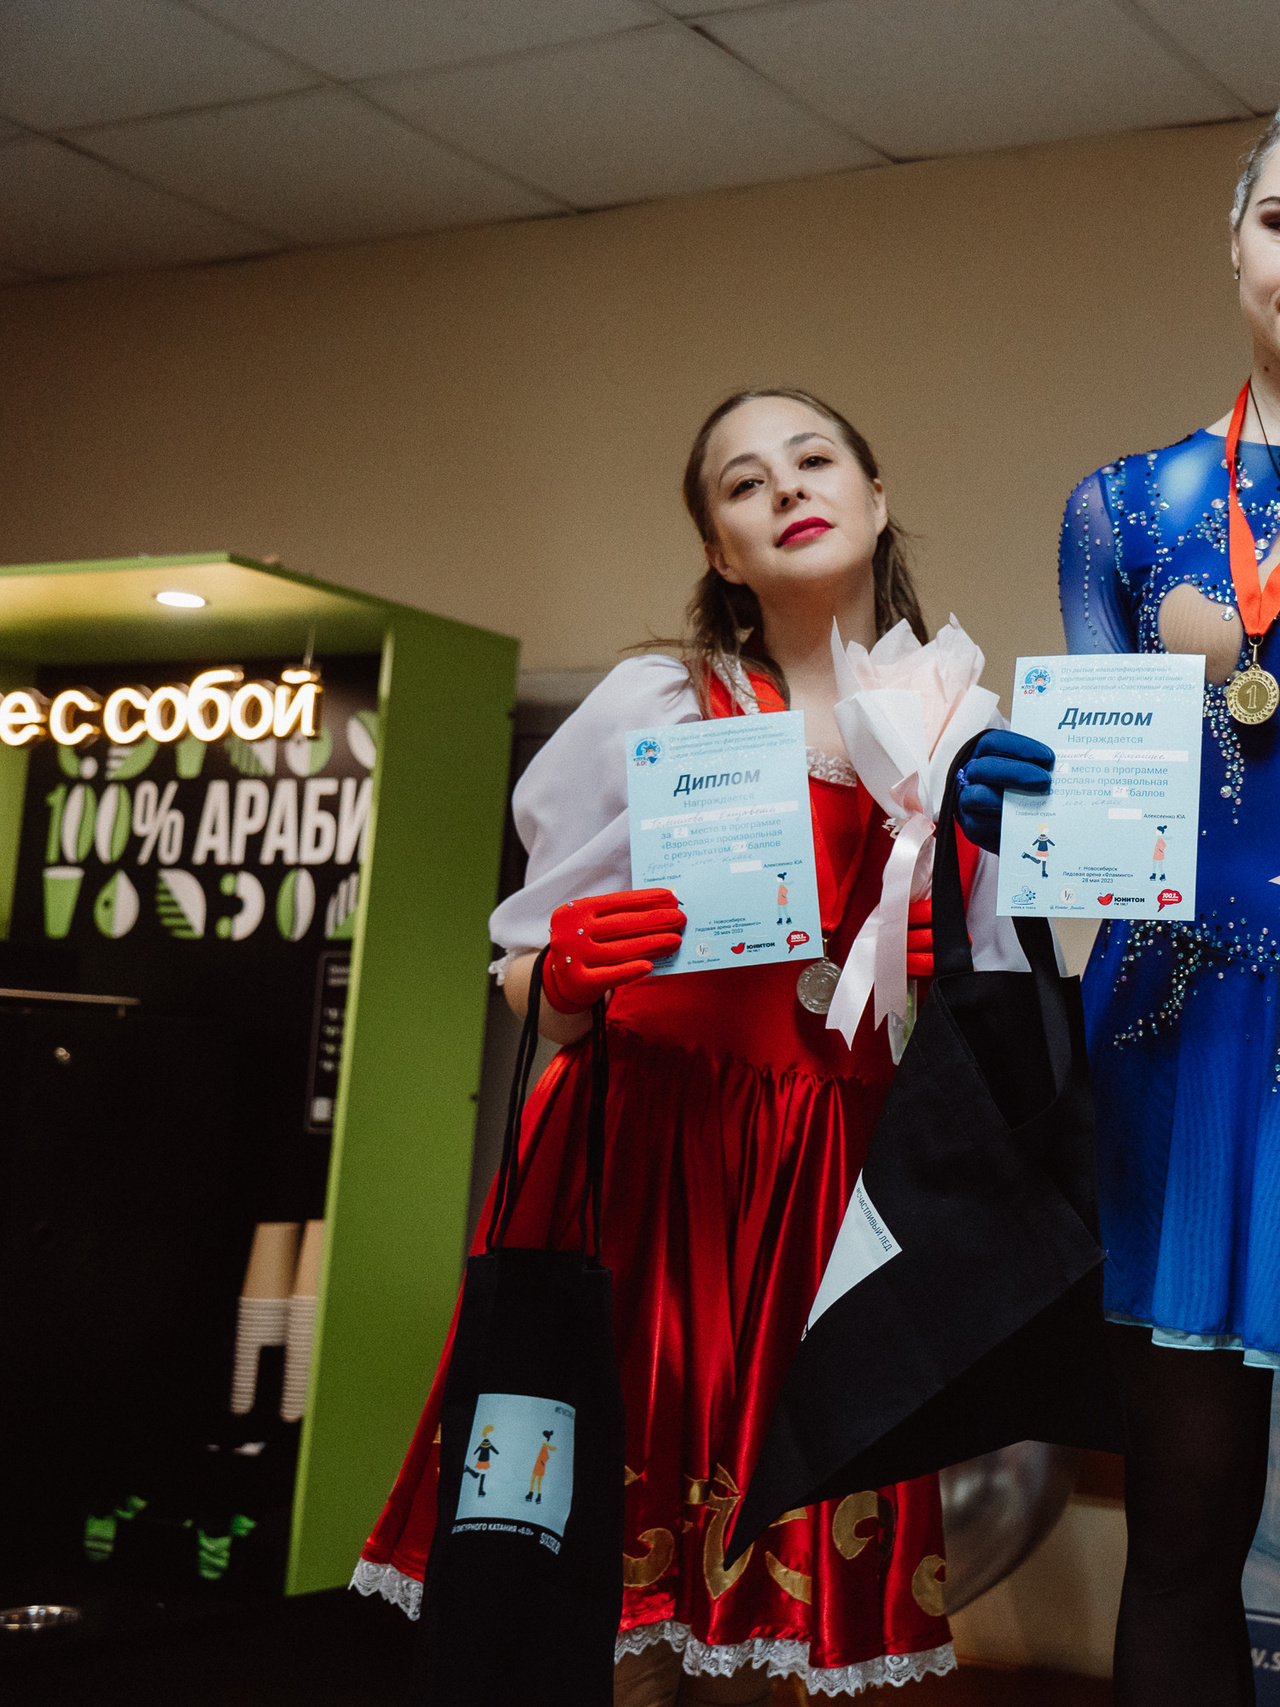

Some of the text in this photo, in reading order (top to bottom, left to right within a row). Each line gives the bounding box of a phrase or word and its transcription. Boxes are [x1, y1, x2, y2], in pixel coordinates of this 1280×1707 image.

[1246, 684, 1257, 709] 1
[50, 688, 101, 747] с
[103, 666, 323, 745] собой
[1058, 707, 1153, 729] Диплом
[1067, 734, 1144, 745] Награждается
[1071, 766, 1102, 774] место
[1112, 766, 1168, 776] программе
[673, 769, 761, 797] Диплом
[1097, 778, 1168, 787] произвольная
[683, 793, 755, 809] Награждается
[1129, 787, 1165, 798] баллов
[45, 777, 375, 867] 100% АРАБИ
[690, 826, 719, 836] место
[729, 818, 781, 832] программе
[661, 832, 672, 840] за
[661, 837, 715, 852] «Взрослая»
[716, 829, 783, 845] произвольная
[664, 852, 670, 861] с
[671, 846, 731, 862] результатом
[748, 839, 781, 850] баллов
[1114, 896, 1145, 904] ЮНИТОН
[878, 1234, 893, 1253] ЛЕД
